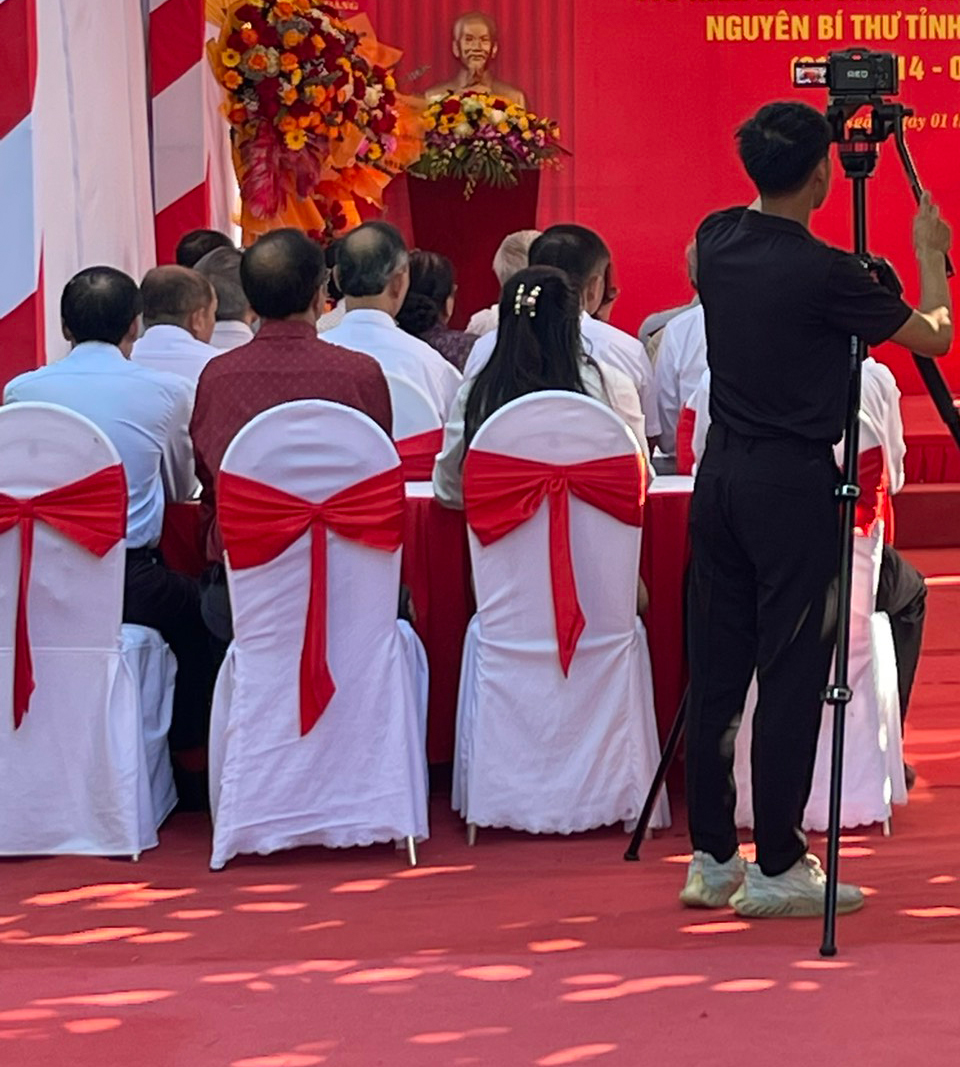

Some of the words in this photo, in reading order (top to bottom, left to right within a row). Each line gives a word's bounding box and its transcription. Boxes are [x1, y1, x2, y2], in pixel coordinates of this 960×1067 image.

[706, 9, 810, 41] NGUYÊN
[817, 9, 843, 40] BÍ
[850, 10, 902, 40] THƯ
[930, 114, 947, 128] 01
